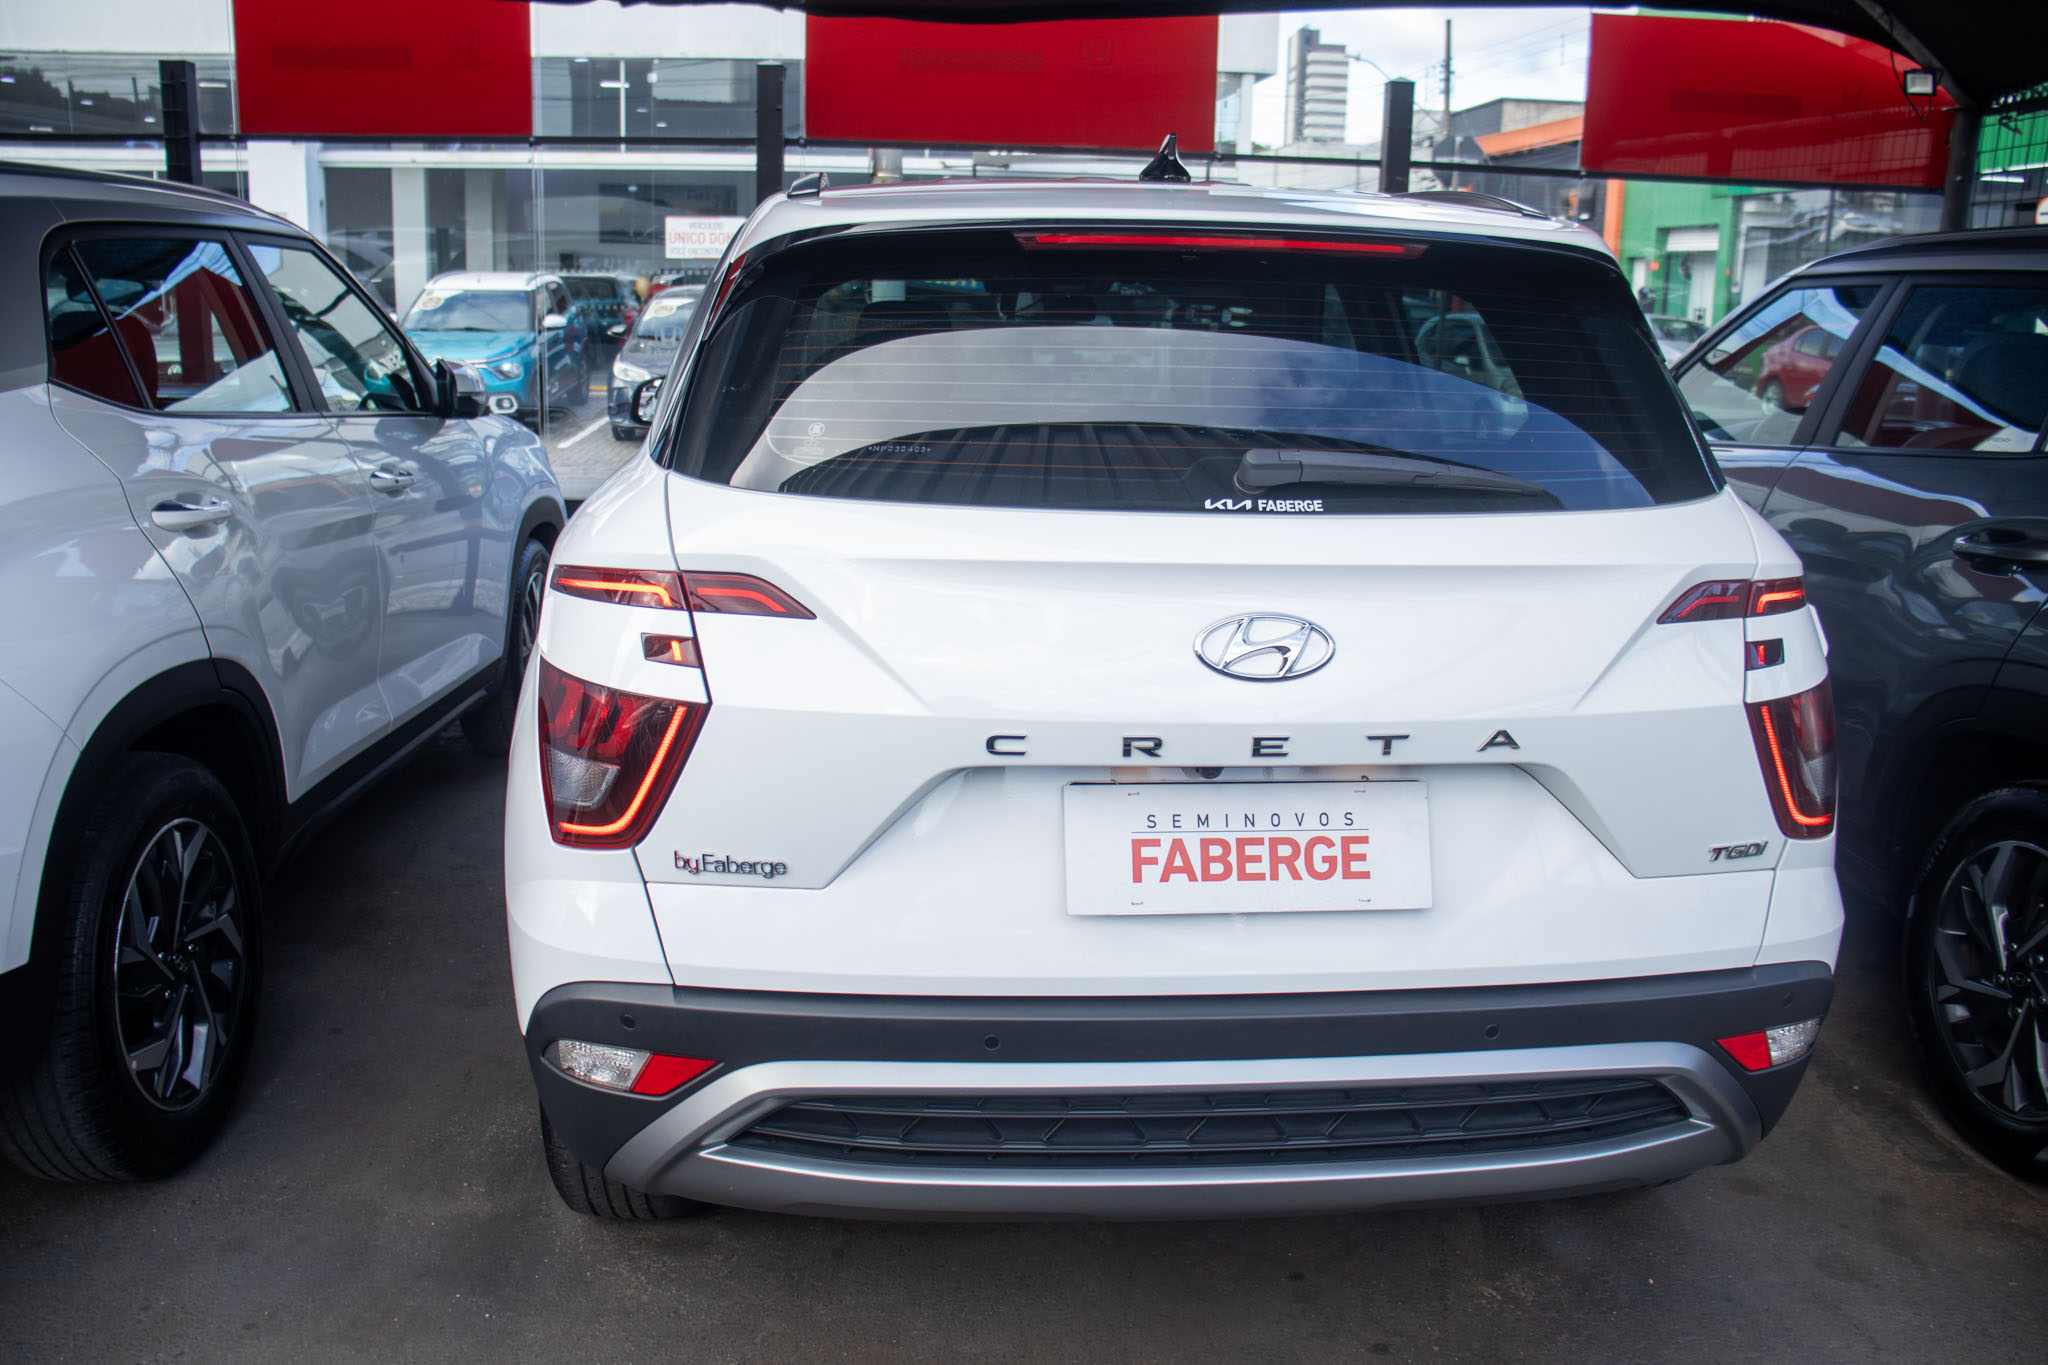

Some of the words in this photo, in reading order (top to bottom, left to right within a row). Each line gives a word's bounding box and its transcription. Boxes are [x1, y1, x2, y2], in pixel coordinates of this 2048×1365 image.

[709, 231, 734, 245] DON
[1258, 499, 1324, 512] FABERGE
[985, 728, 1521, 759] CRETA
[1146, 812, 1354, 829] SEMINOVOS
[1131, 835, 1371, 883] FABERGE
